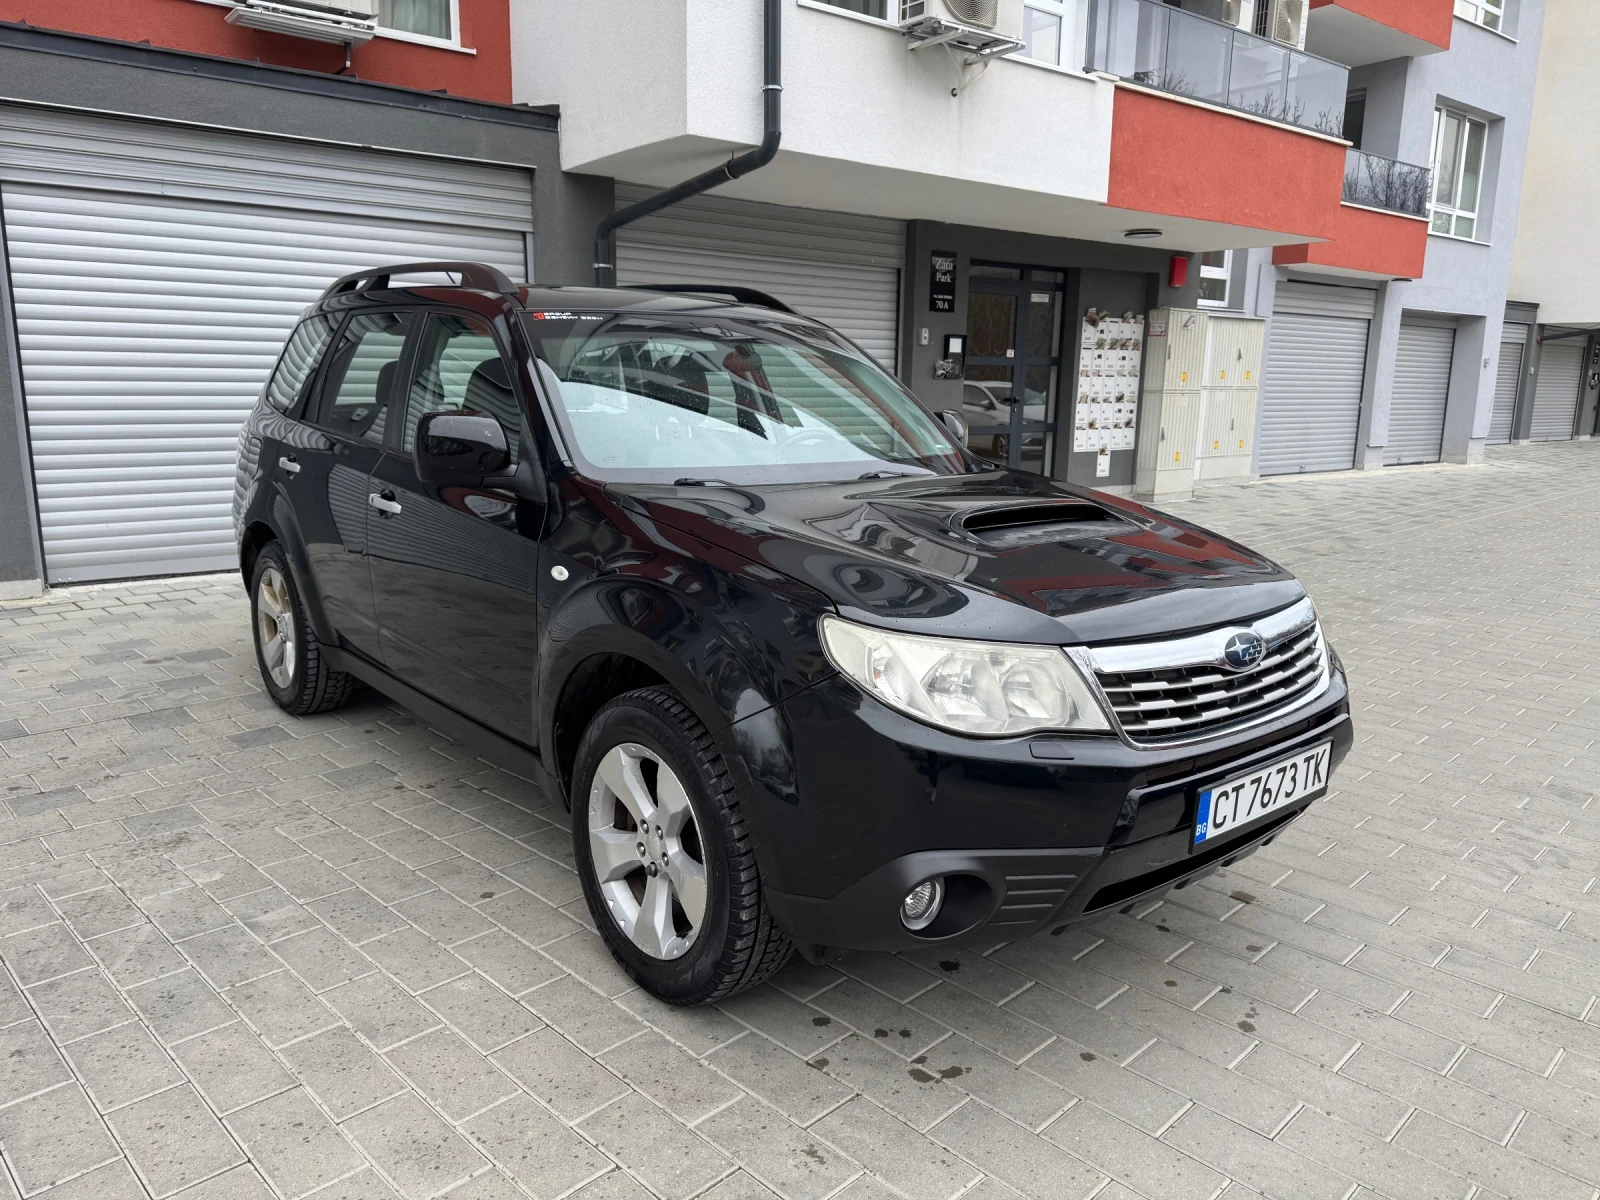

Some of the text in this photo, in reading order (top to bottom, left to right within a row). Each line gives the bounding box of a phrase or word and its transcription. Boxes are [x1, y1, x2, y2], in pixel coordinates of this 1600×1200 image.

[935, 258, 953, 271] Zara
[936, 272, 952, 283] Park
[935, 300, 943, 309] 70
[1195, 822, 1207, 837] BG
